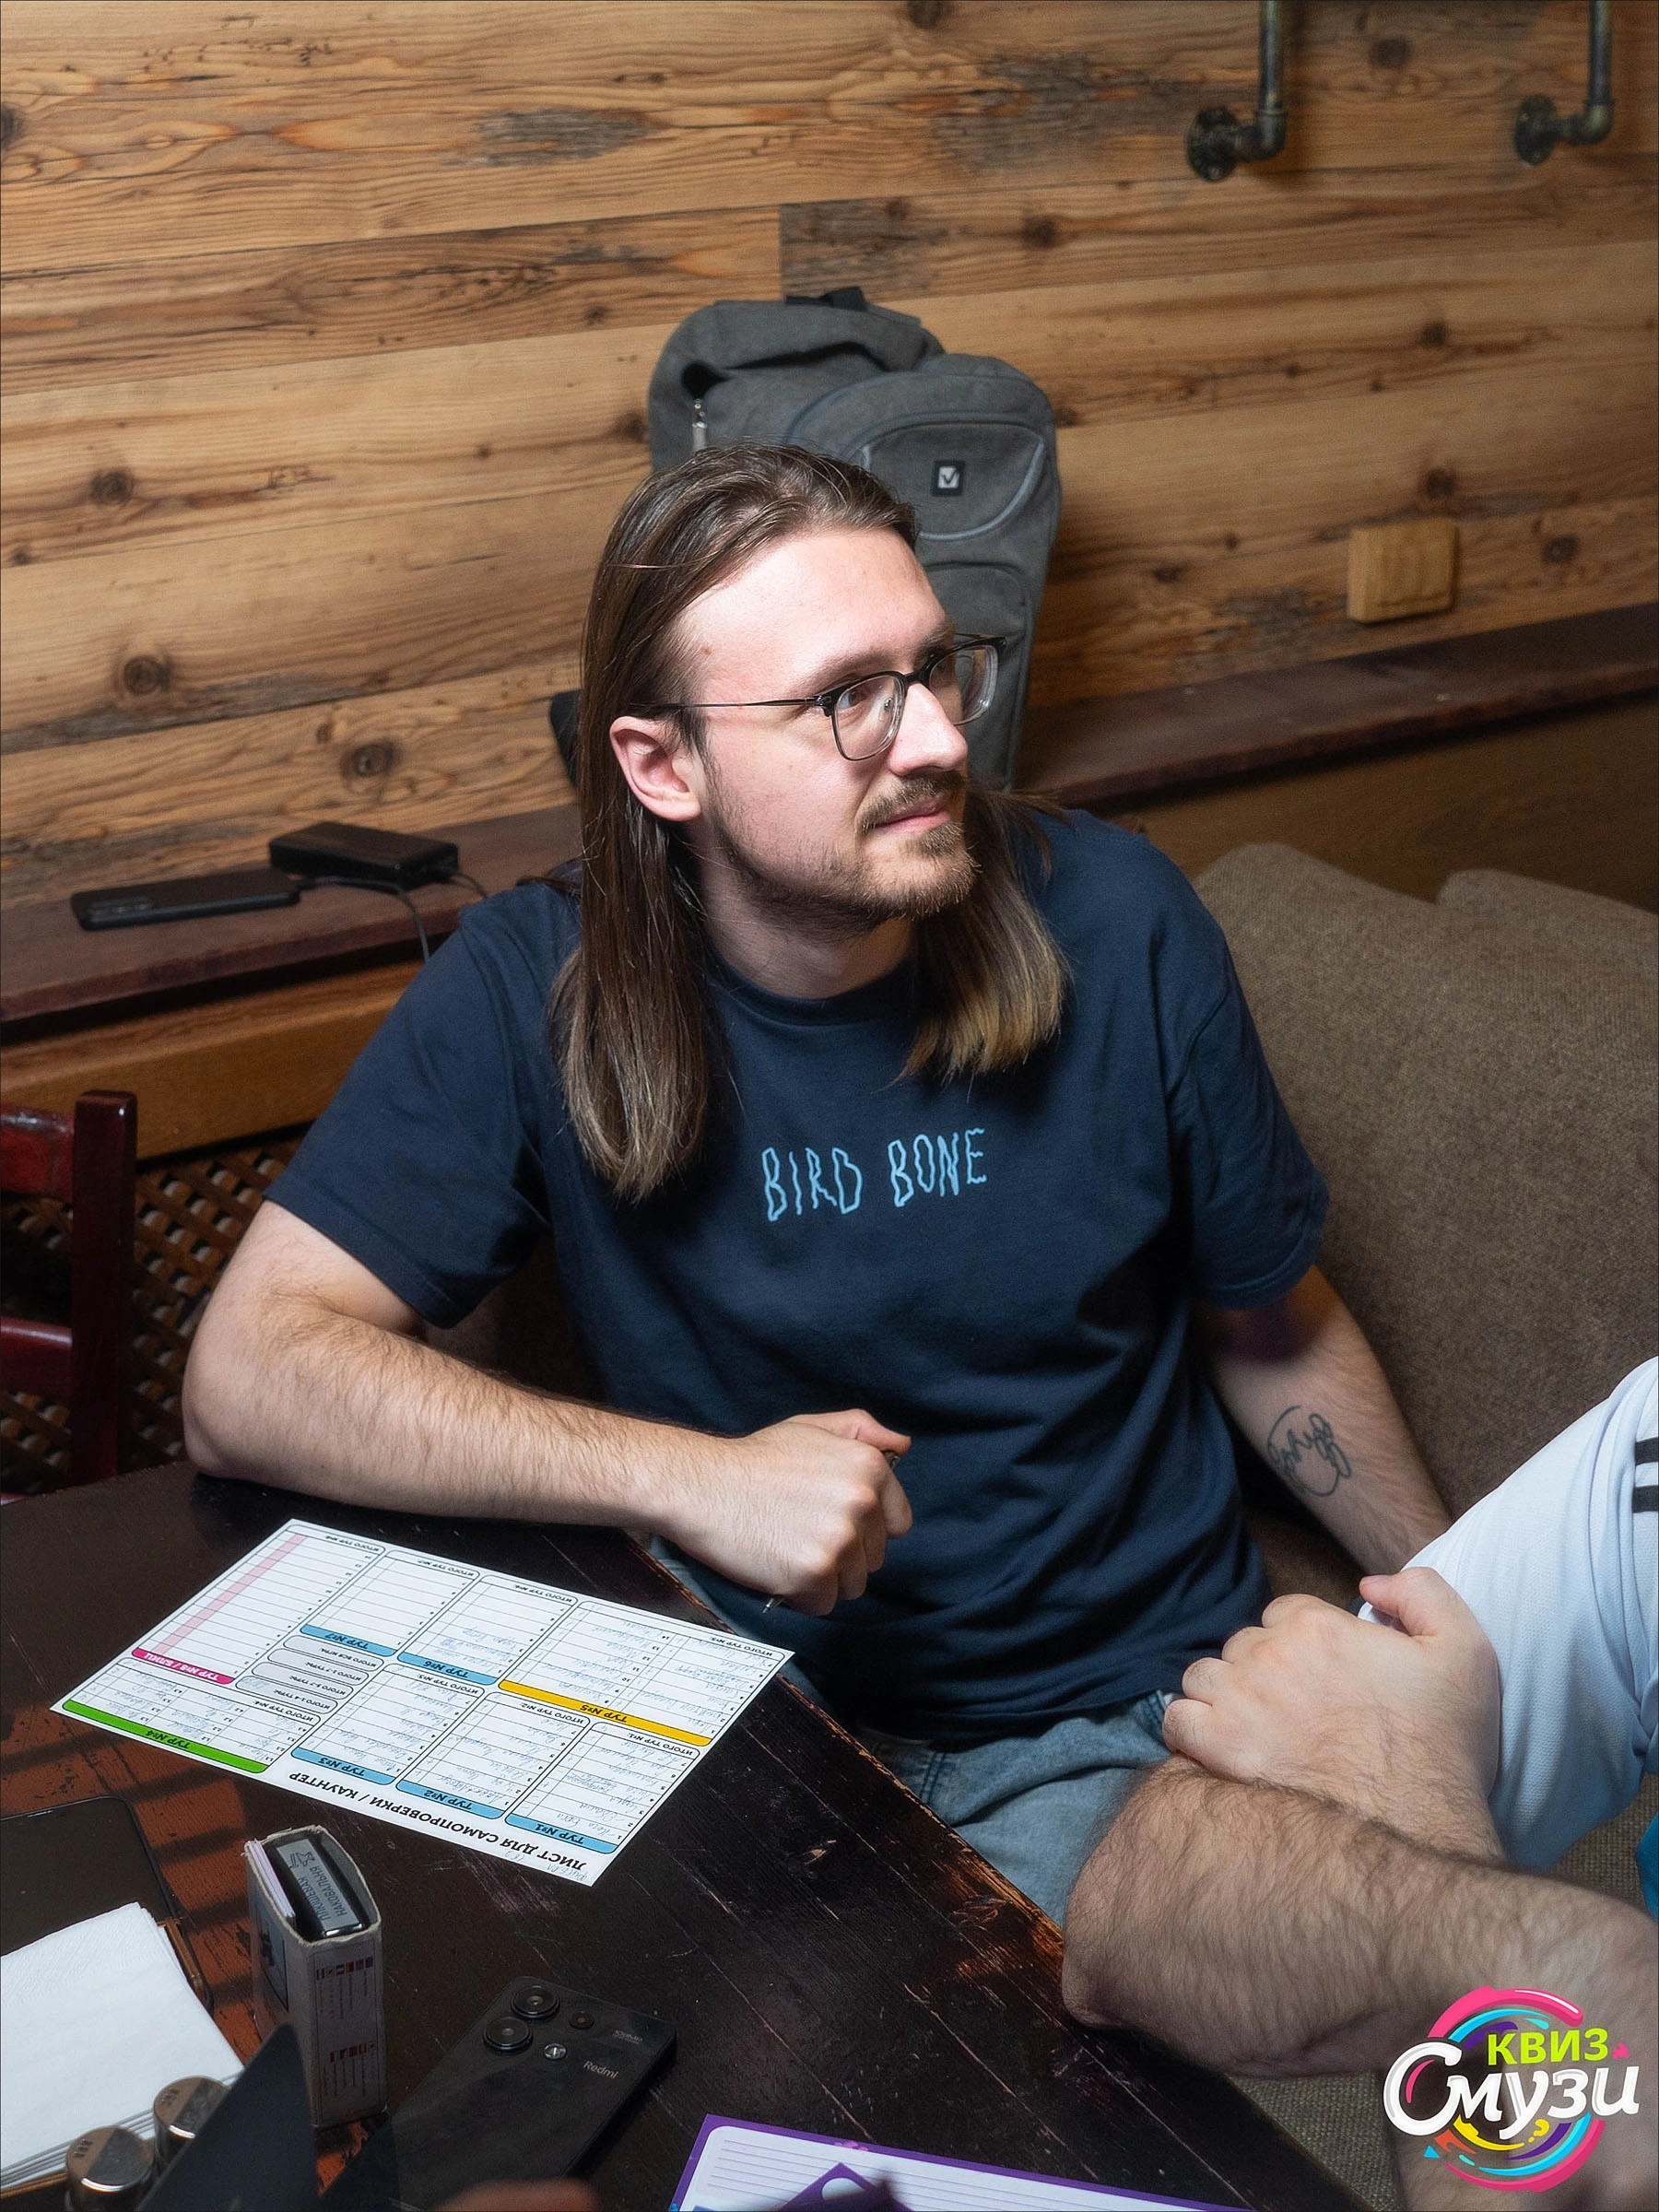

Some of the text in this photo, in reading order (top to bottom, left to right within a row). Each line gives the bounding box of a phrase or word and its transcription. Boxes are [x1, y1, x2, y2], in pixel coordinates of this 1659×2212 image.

[761, 1127, 988, 1222] BIRD BONE
[345, 1638, 371, 1649] ТУР
[197, 1670, 221, 1680] ТУР
[421, 1660, 471, 1677] ТУР №6
[579, 1704, 629, 1722] ТУР №5
[165, 1736, 194, 1748] ТУР
[642, 1737, 663, 1746] ТУР
[660, 1743, 694, 1755] ИТОГО
[317, 1757, 342, 1768] №3
[339, 1763, 368, 1776] ТУР
[287, 1771, 359, 1798] КАУНТЕР
[421, 1789, 475, 1809] ТУР №2
[367, 1795, 500, 1844] САМОПРОВЕРКИ
[532, 1823, 586, 1844] ТУР №1
[499, 1836, 538, 1855] ДЛЯ
[535, 1849, 586, 1871] ЛИСТ
[310, 1865, 348, 1917] НАКОВАЛЬНЯ
[583, 2060, 619, 2079] Redmi
